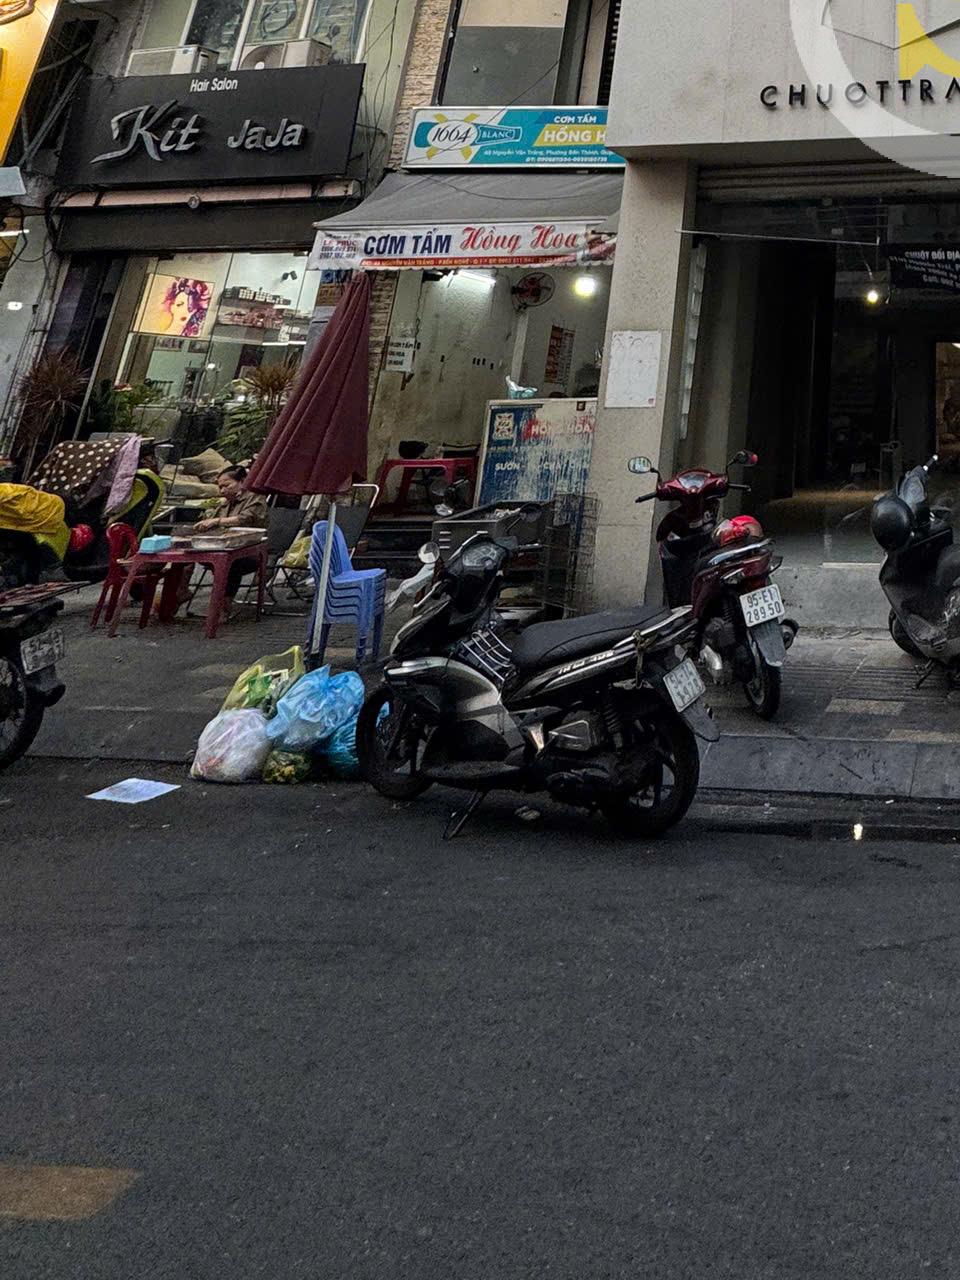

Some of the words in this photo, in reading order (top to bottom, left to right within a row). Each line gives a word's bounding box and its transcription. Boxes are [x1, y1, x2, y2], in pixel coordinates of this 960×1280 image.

[190, 78, 210, 92] Hair
[211, 77, 238, 91] Salon
[554, 114, 576, 124] CƠM
[577, 112, 597, 124] TẤM
[90, 99, 201, 164] Kit
[432, 123, 472, 143] 1664
[480, 129, 513, 140] BLANC
[363, 233, 407, 256] CƠM
[411, 227, 453, 255] TẤM
[460, 225, 521, 255] Hồng
[530, 224, 580, 250] Hoa
